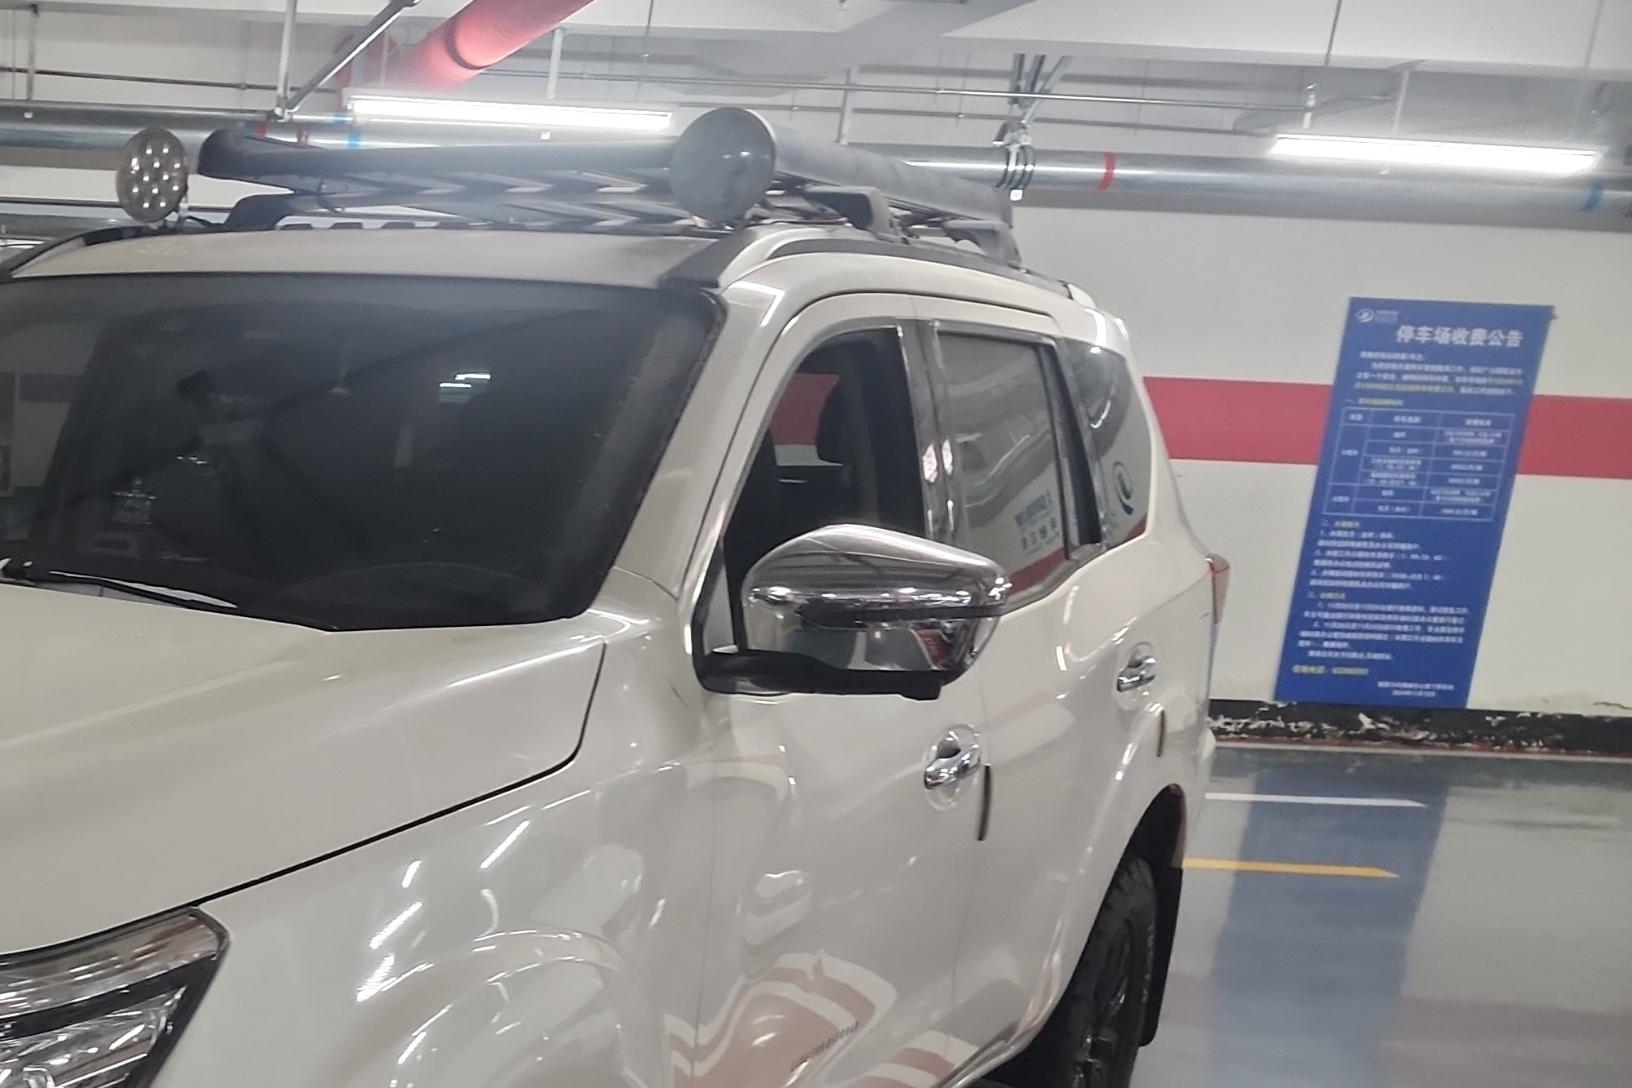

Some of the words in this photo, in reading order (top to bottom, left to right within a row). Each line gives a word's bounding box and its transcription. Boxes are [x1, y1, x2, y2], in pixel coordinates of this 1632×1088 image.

[1396, 323, 1523, 348] 停车场收费公告
